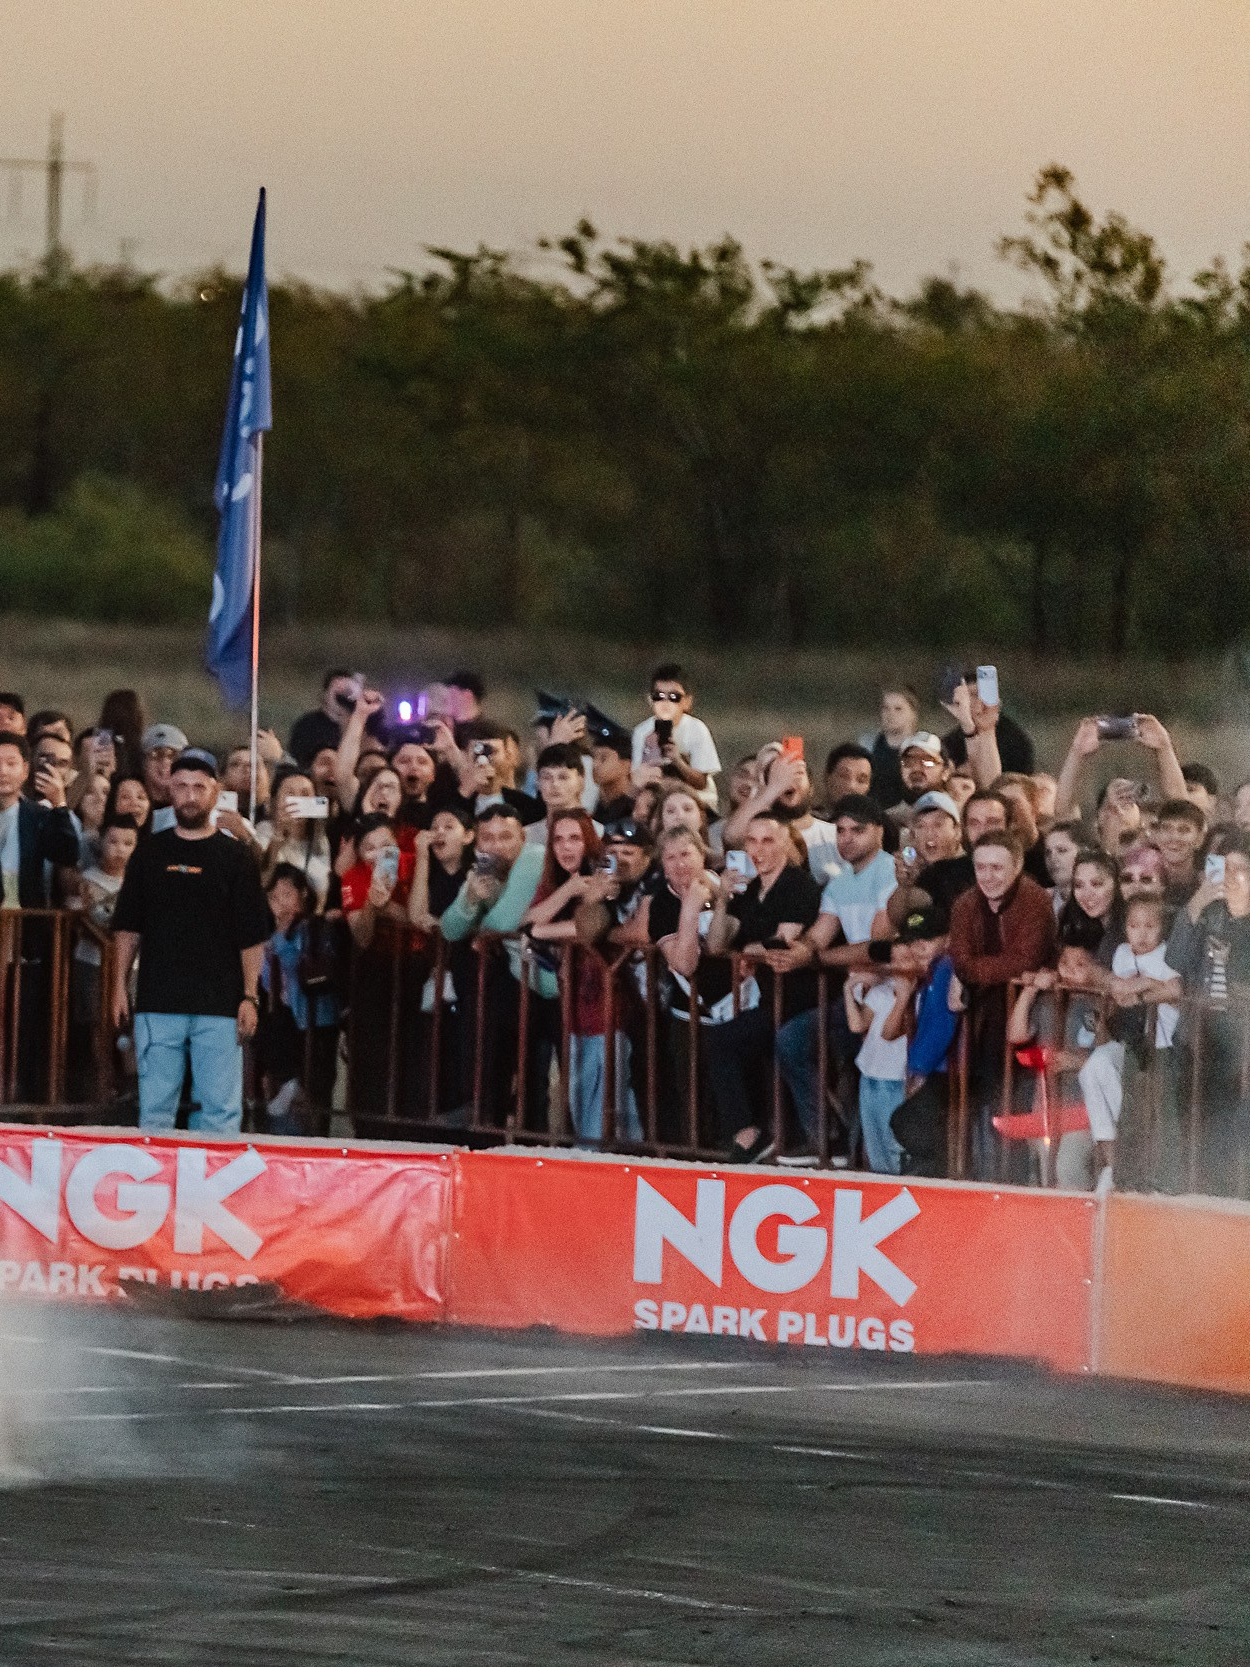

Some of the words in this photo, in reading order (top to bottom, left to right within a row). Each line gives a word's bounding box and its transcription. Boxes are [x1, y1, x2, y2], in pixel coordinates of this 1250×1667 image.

[633, 1175, 921, 1307] NGK
[634, 1299, 768, 1342] SPARK
[777, 1311, 916, 1352] PLUGS
